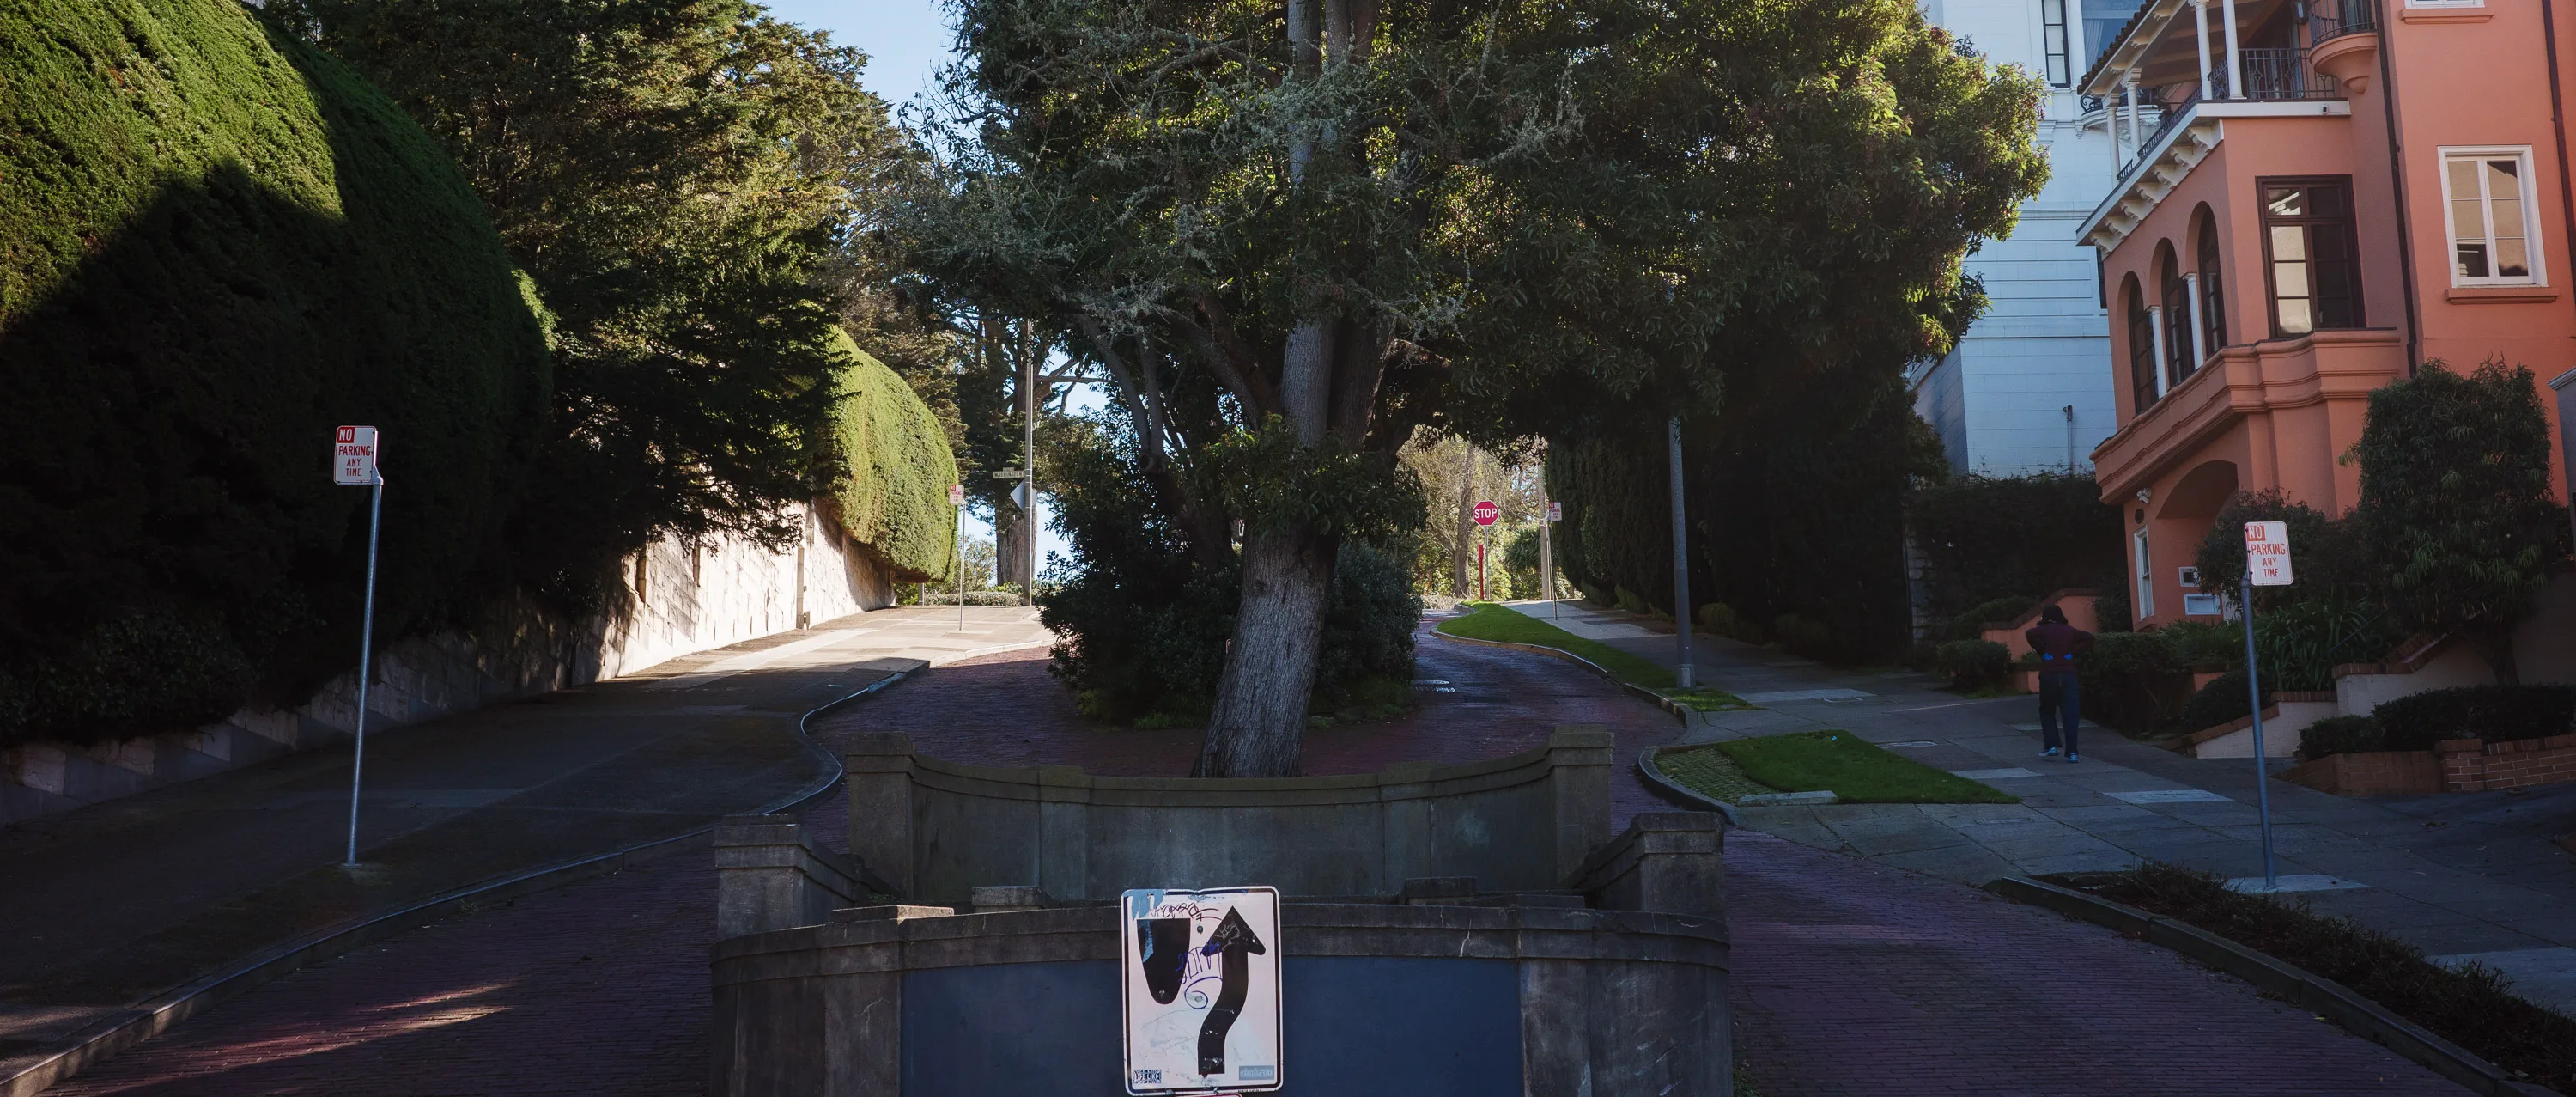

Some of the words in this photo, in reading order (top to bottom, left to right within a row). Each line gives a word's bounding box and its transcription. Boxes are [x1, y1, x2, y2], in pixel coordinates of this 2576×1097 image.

[338, 429, 353, 441] NO
[338, 445, 371, 456] PARKING
[346, 458, 361, 466] ANY
[345, 467, 361, 477] TIME
[1474, 508, 1498, 519] STOP
[2248, 525, 2263, 539] NO
[2251, 543, 2286, 556] PARKING
[2263, 558, 2277, 566] ANY
[2263, 568, 2280, 577] TIME
